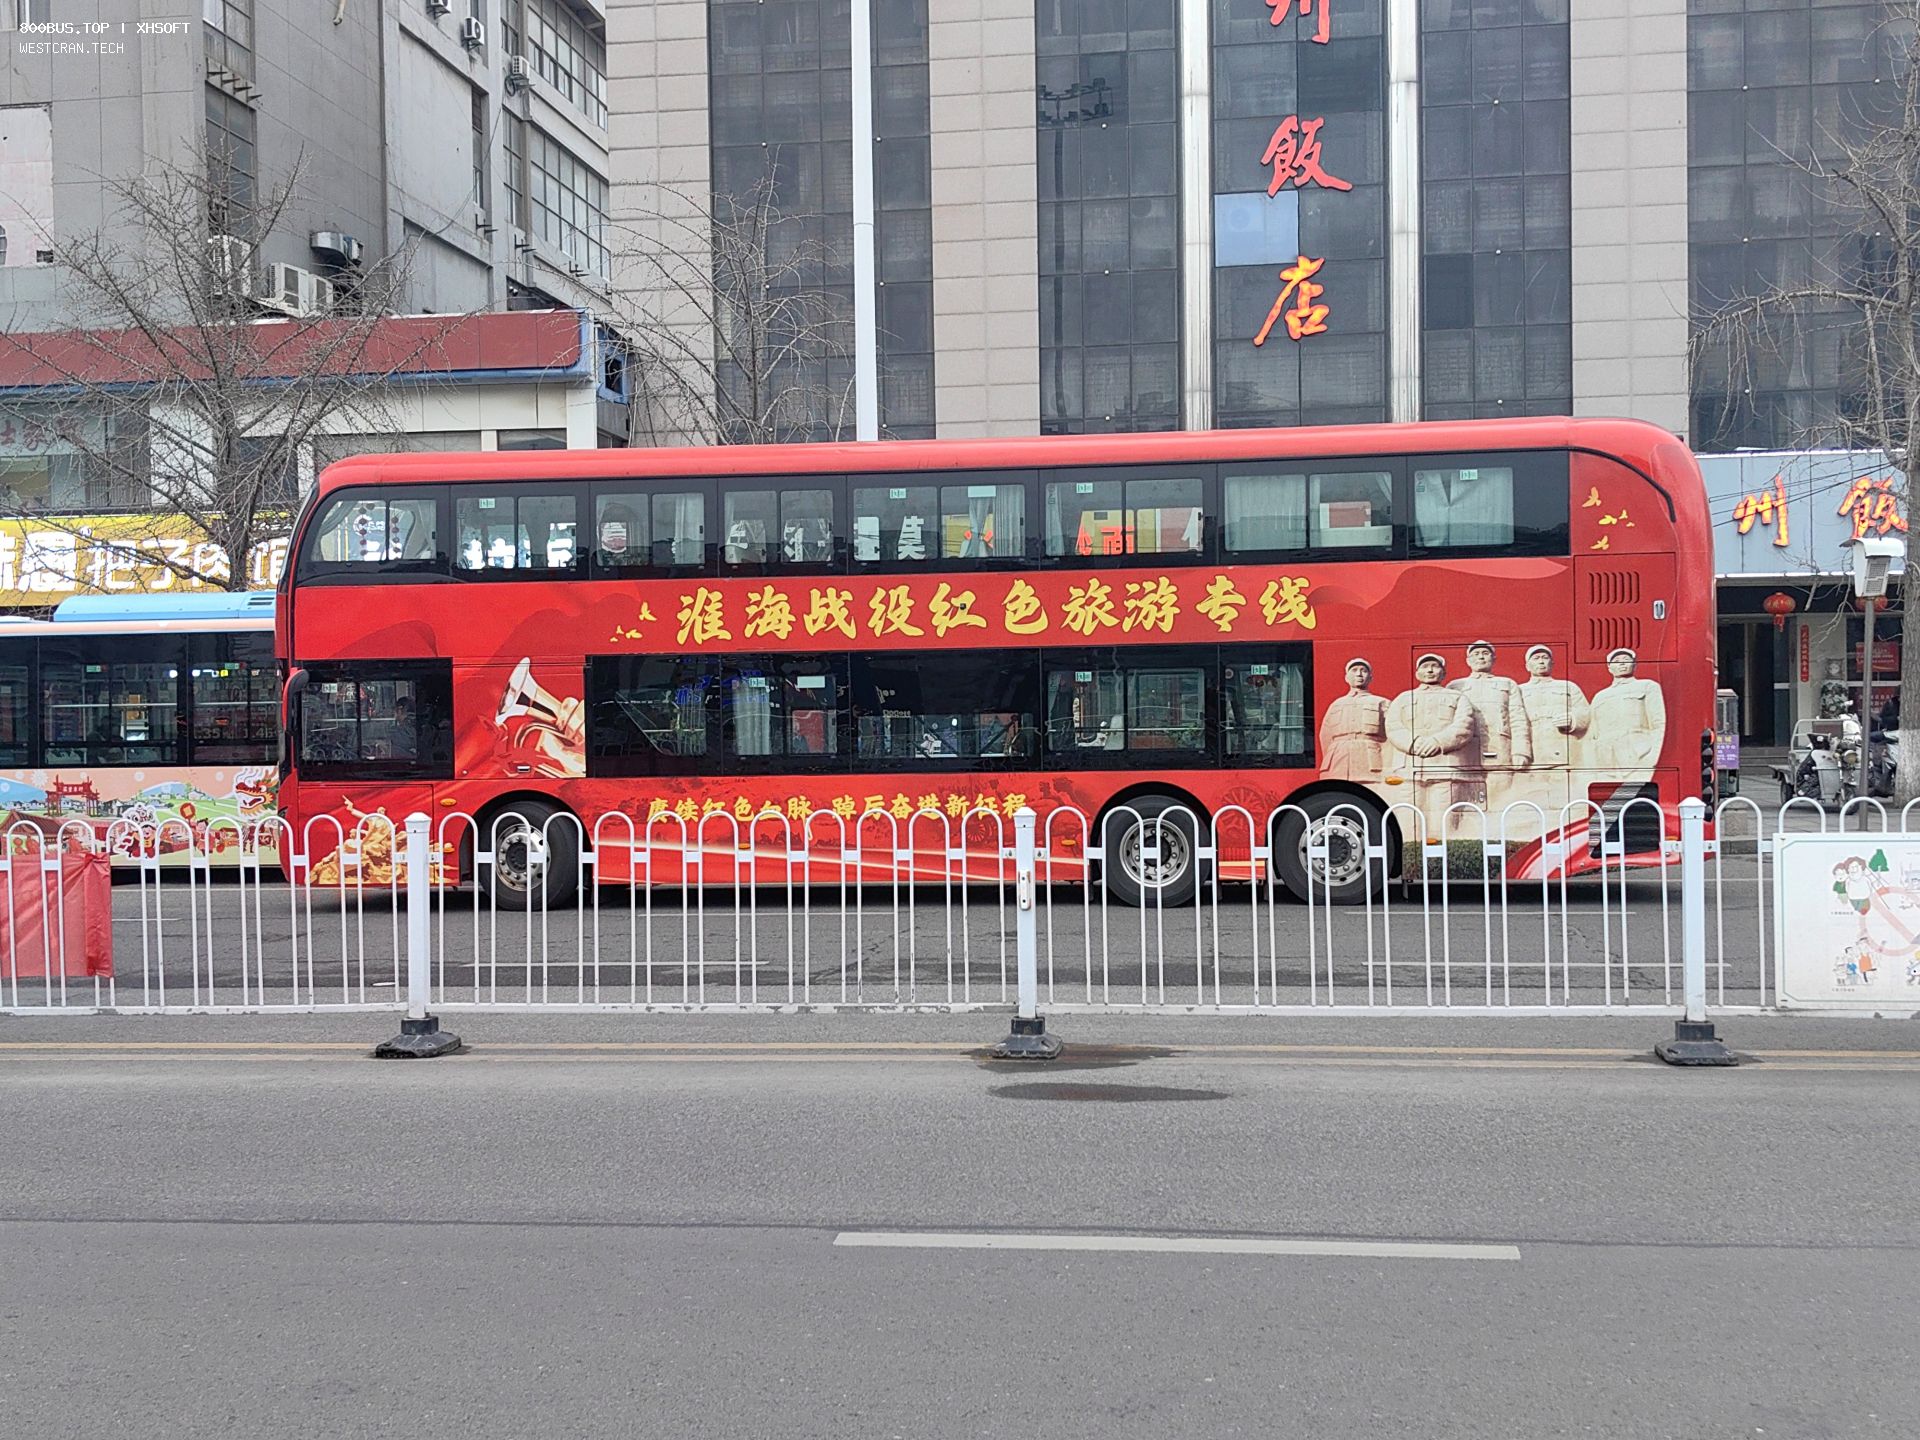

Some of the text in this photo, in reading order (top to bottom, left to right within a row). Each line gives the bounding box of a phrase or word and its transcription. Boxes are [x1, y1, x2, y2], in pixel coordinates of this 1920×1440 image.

[676, 574, 1317, 645] 淮海战役红色旅游专线
[647, 792, 1027, 836] 赓续红色血脉 踔厉奋进新征程
